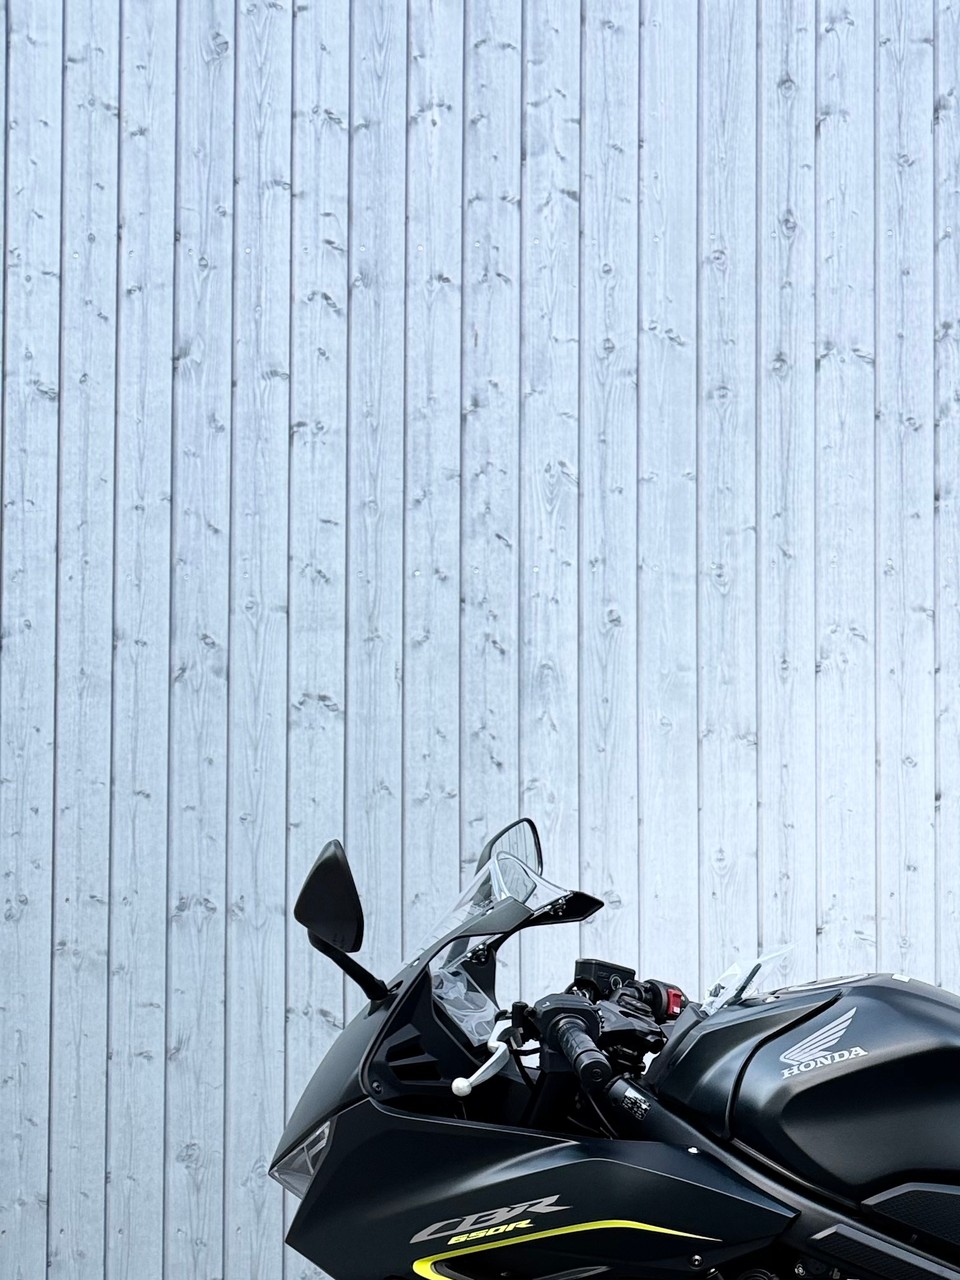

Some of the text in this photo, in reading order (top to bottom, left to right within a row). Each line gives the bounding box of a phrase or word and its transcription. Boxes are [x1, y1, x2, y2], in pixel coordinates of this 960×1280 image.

[781, 1046, 868, 1079] HONDA
[409, 1194, 573, 1244] CBR
[447, 1219, 534, 1245] 650R
